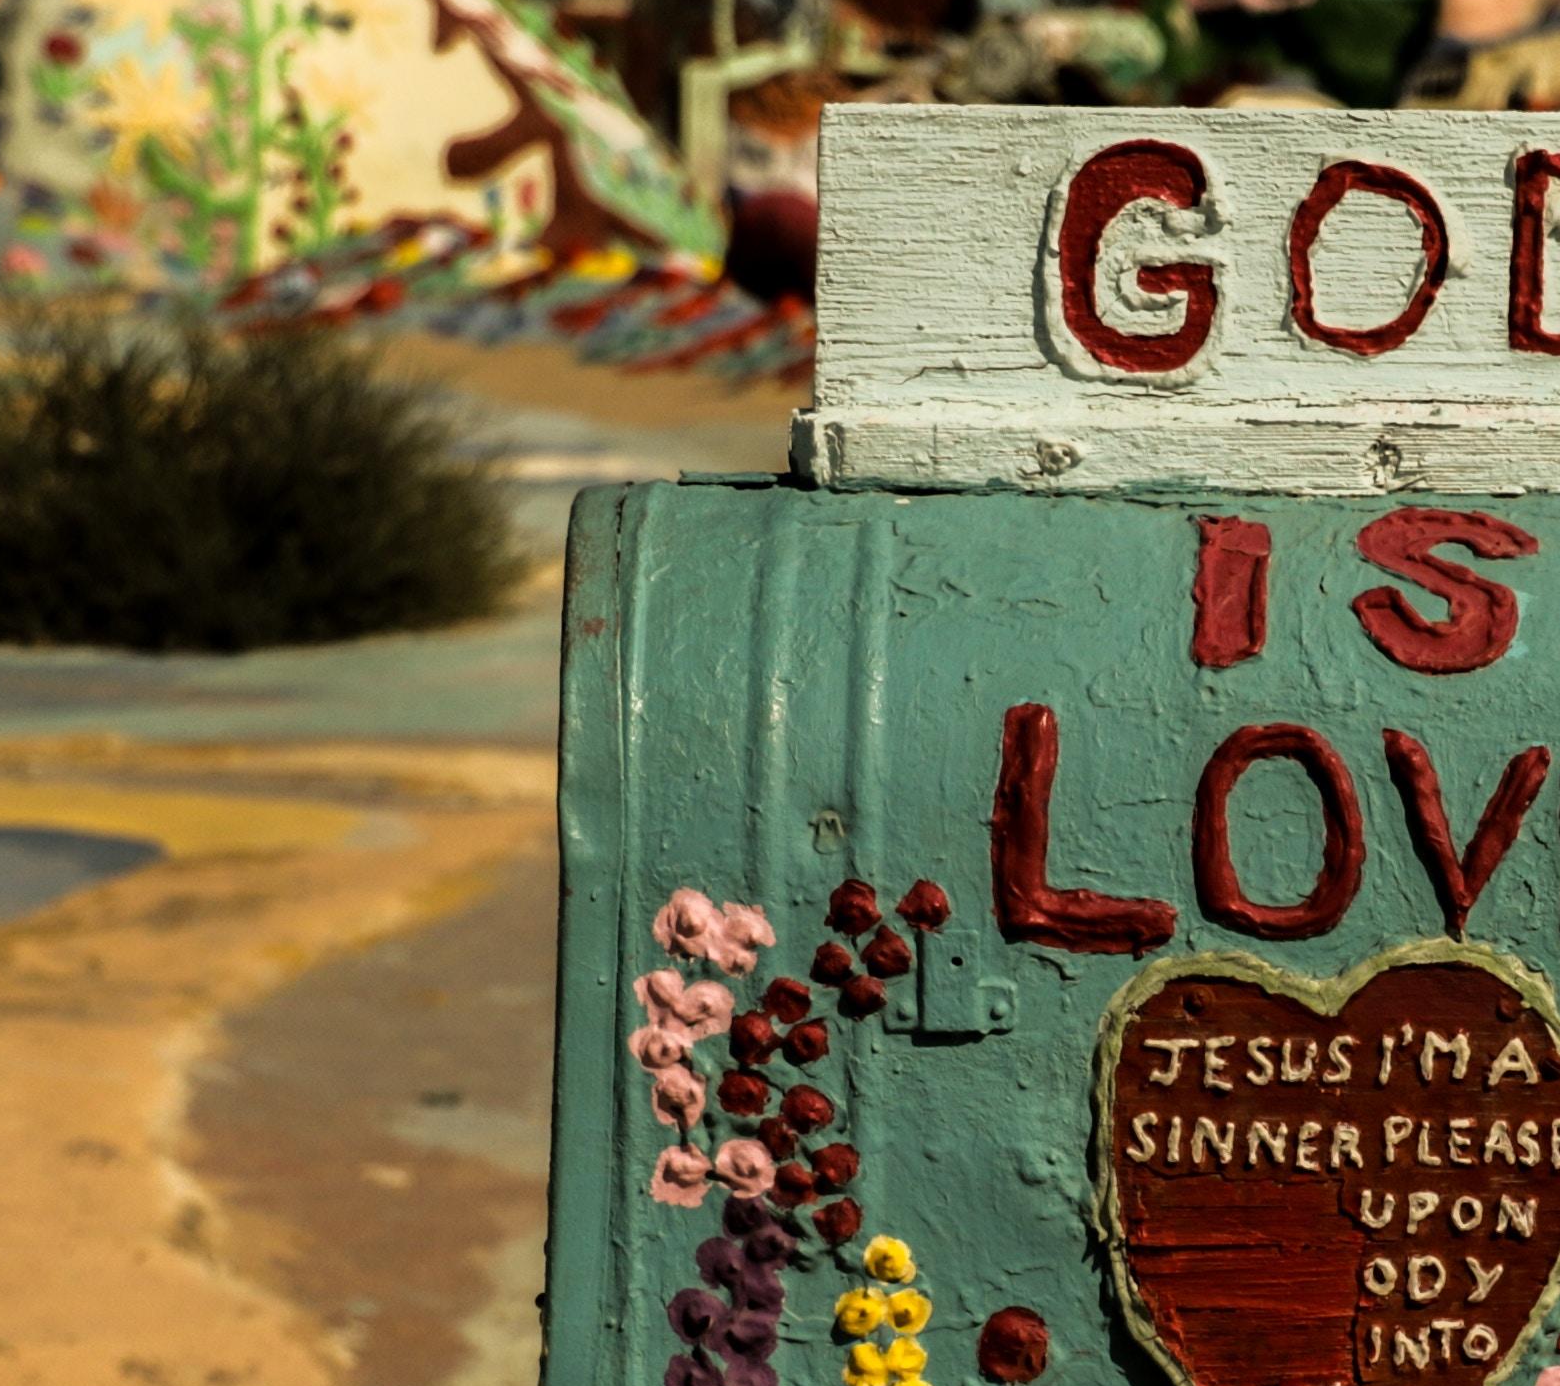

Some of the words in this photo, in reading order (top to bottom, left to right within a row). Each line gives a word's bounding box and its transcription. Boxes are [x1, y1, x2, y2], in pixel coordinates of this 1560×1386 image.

[1192, 507, 1539, 676] IS
[1144, 1035, 1359, 1091] JESUS
[1488, 1037, 1539, 1087] A
[1125, 1111, 1364, 1172] SINNER
[1359, 1189, 1539, 1238] UPON
[1369, 1318, 1499, 1370] INTO
